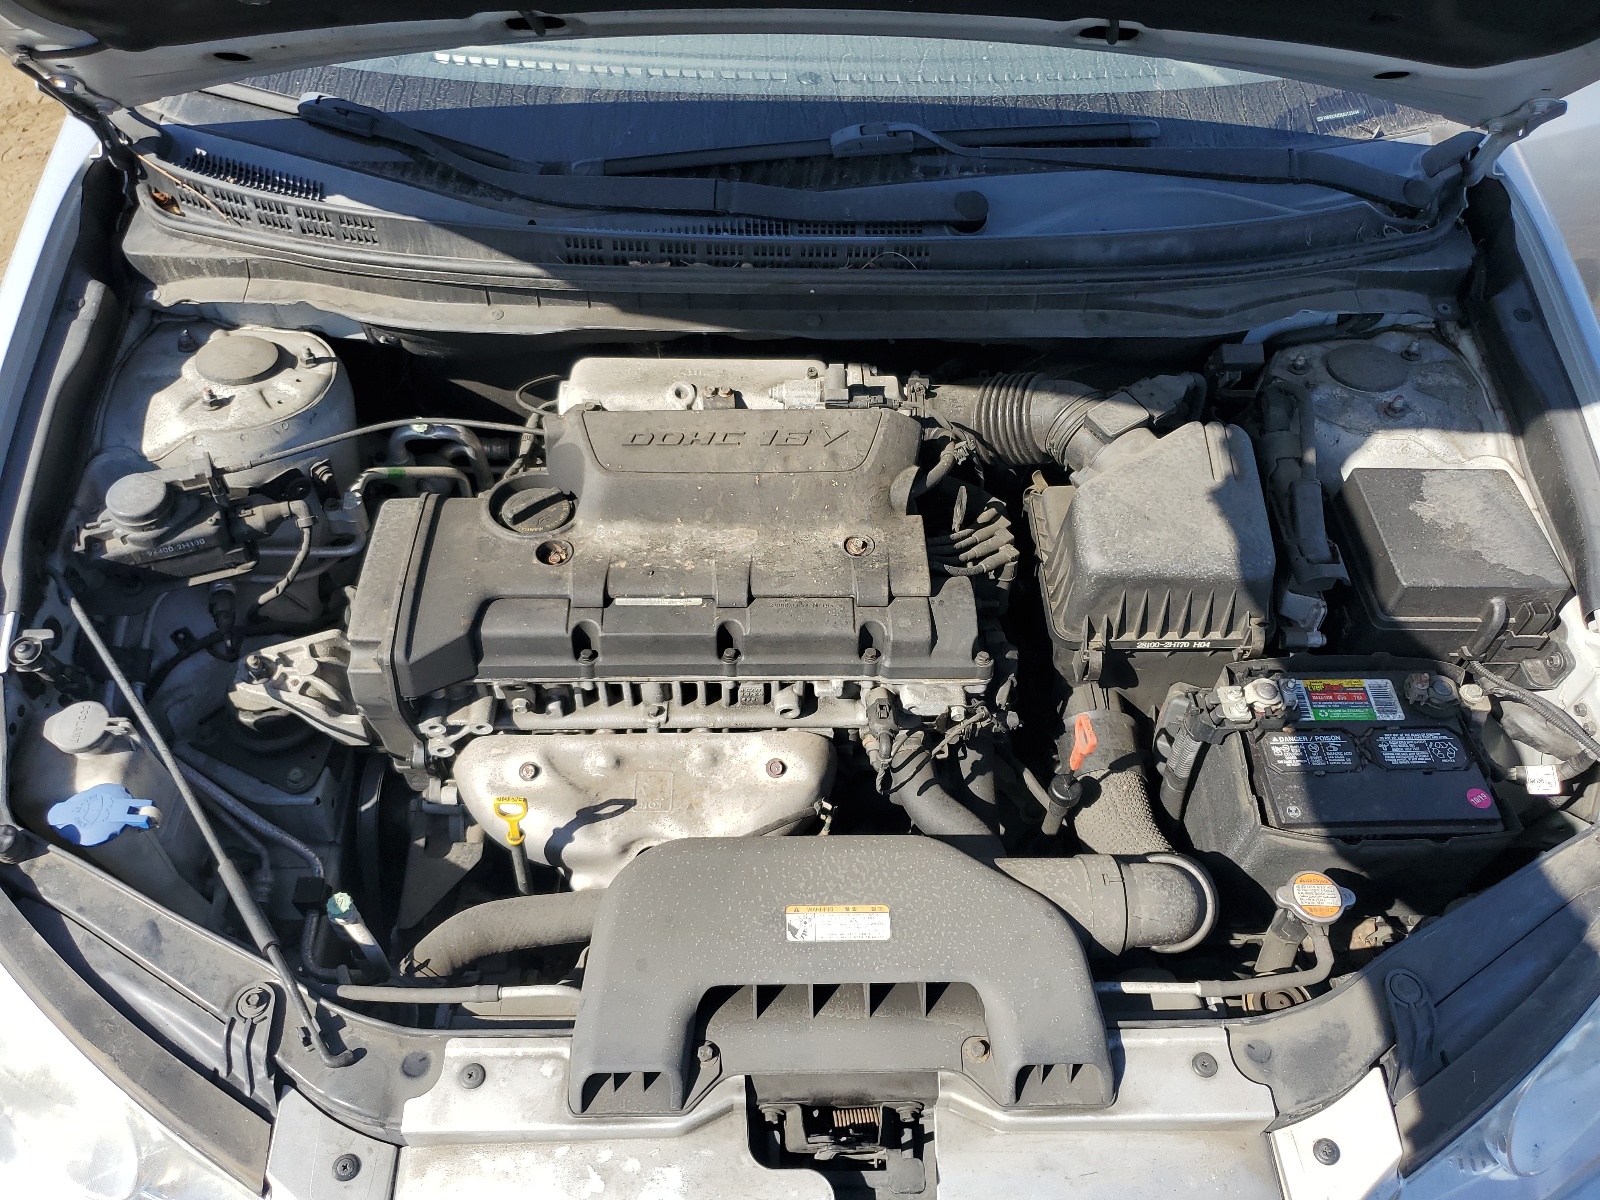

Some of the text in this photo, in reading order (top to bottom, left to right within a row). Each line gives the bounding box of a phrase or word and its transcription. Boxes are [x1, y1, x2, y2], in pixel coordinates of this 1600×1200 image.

[621, 431, 747, 447] DOHC
[1193, 641, 1211, 649] H04
[1278, 735, 1308, 743] DANGER
